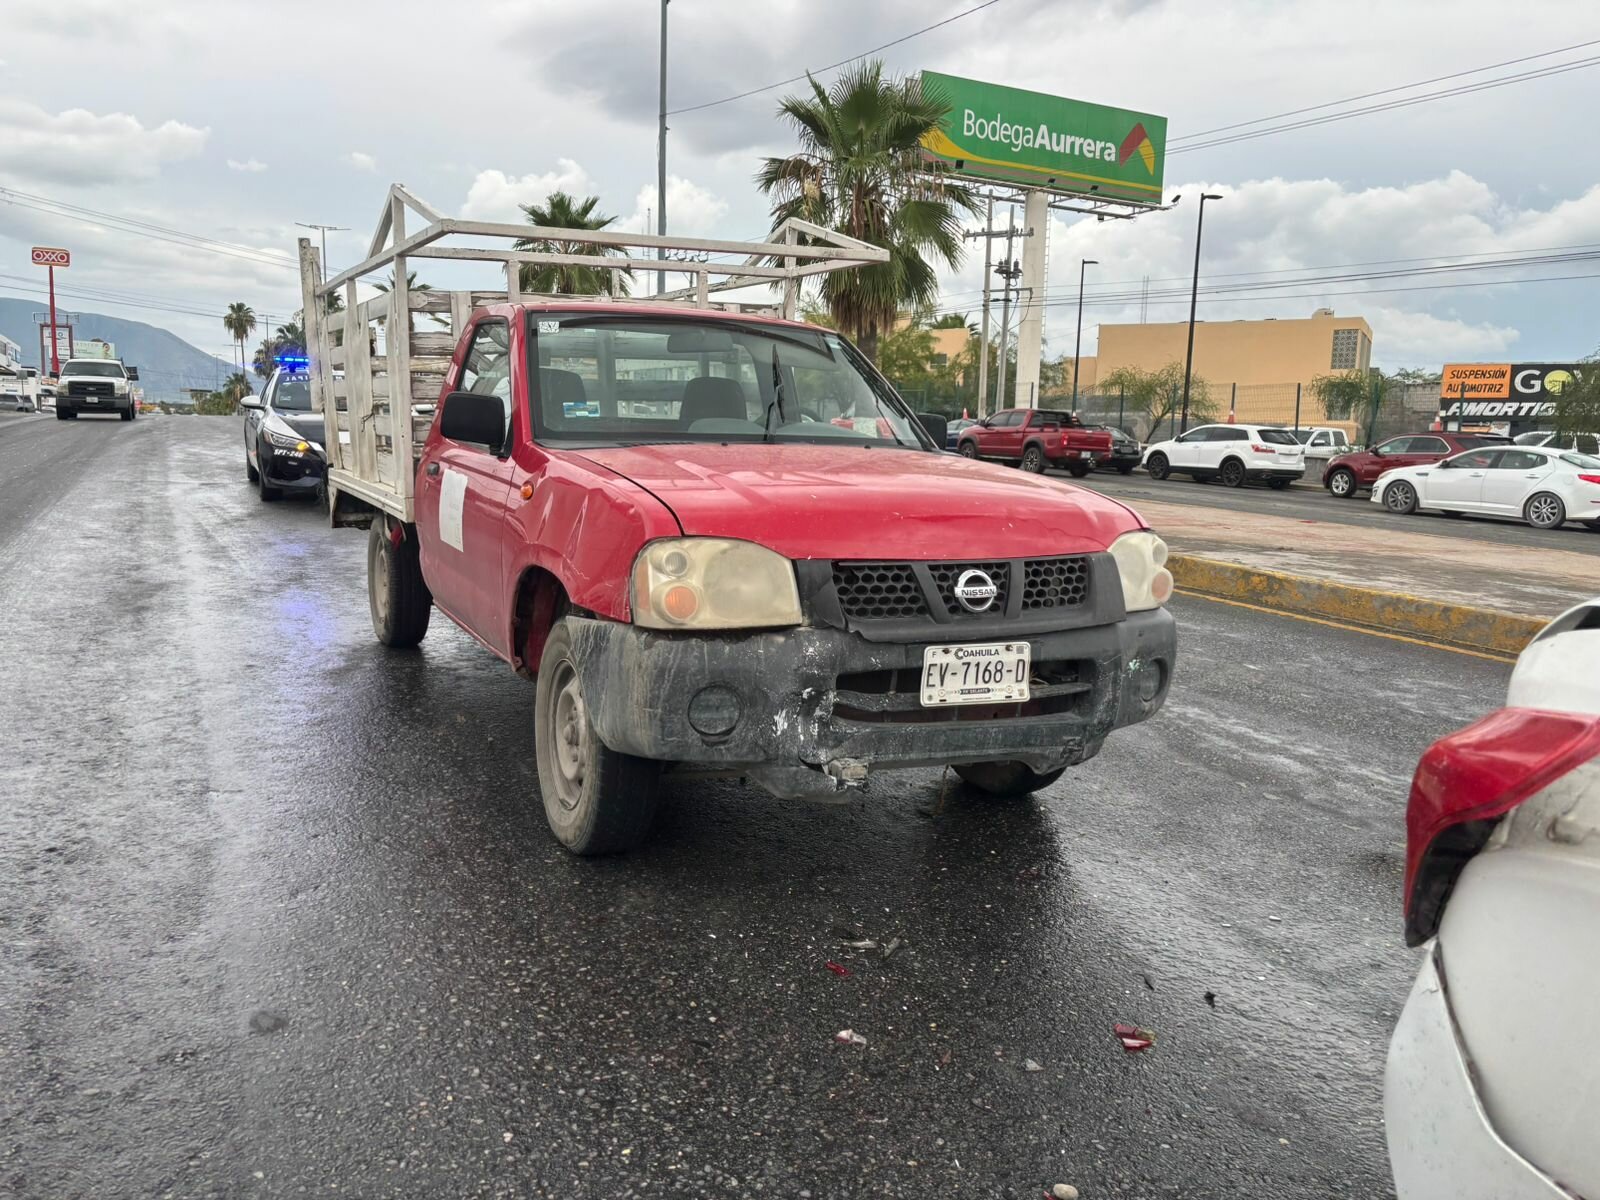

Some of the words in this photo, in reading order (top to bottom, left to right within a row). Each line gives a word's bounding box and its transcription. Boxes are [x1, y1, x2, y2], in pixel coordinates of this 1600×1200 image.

[33, 250, 68, 262] OXXO
[1449, 367, 1507, 380] SUSPENSIÓN
[961, 589, 995, 597] NISSAN
[954, 648, 1000, 660] COAHUILA
